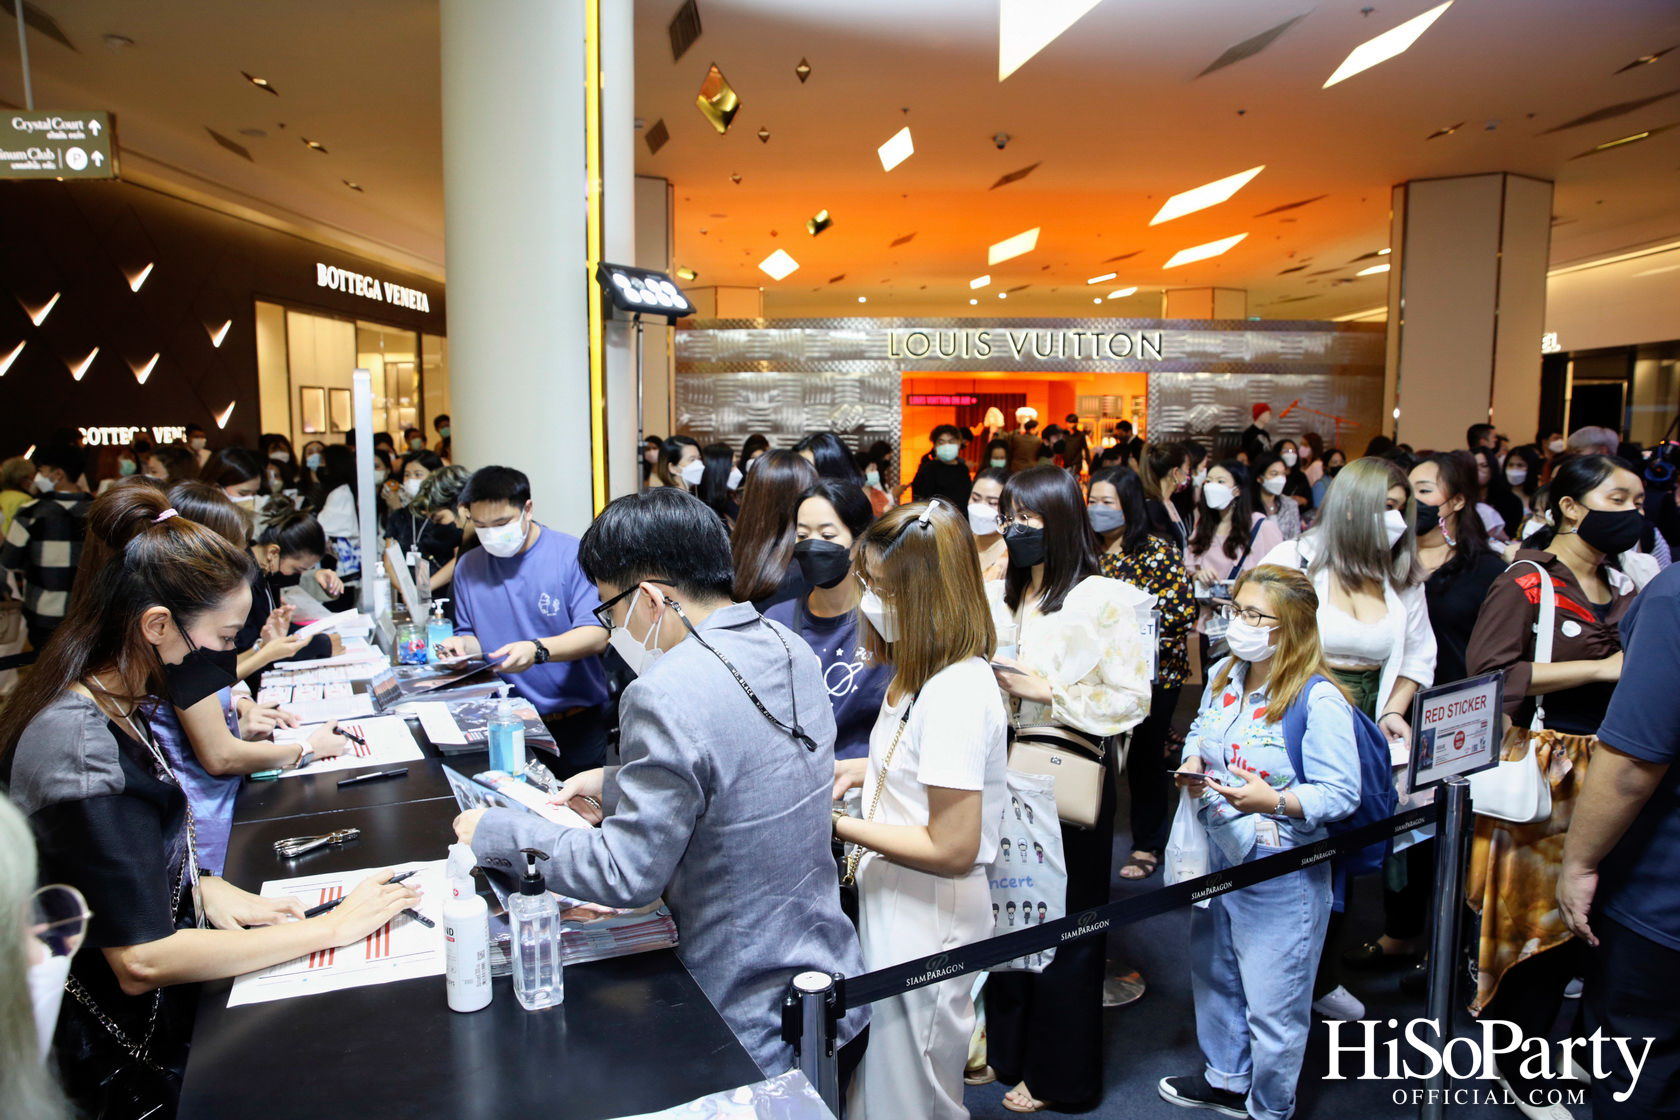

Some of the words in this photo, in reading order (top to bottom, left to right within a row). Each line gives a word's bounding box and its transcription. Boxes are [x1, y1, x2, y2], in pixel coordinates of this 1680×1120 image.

[12, 116, 52, 133] Crystal
[52, 116, 84, 131] Court
[27, 146, 55, 161] Club
[316, 262, 383, 301] BOTTEGA
[383, 281, 430, 313] VENETA
[888, 331, 992, 360] LOUIS
[1005, 330, 1163, 361] VUITTON
[1425, 706, 1445, 725] RED
[1447, 694, 1487, 719] STICKER
